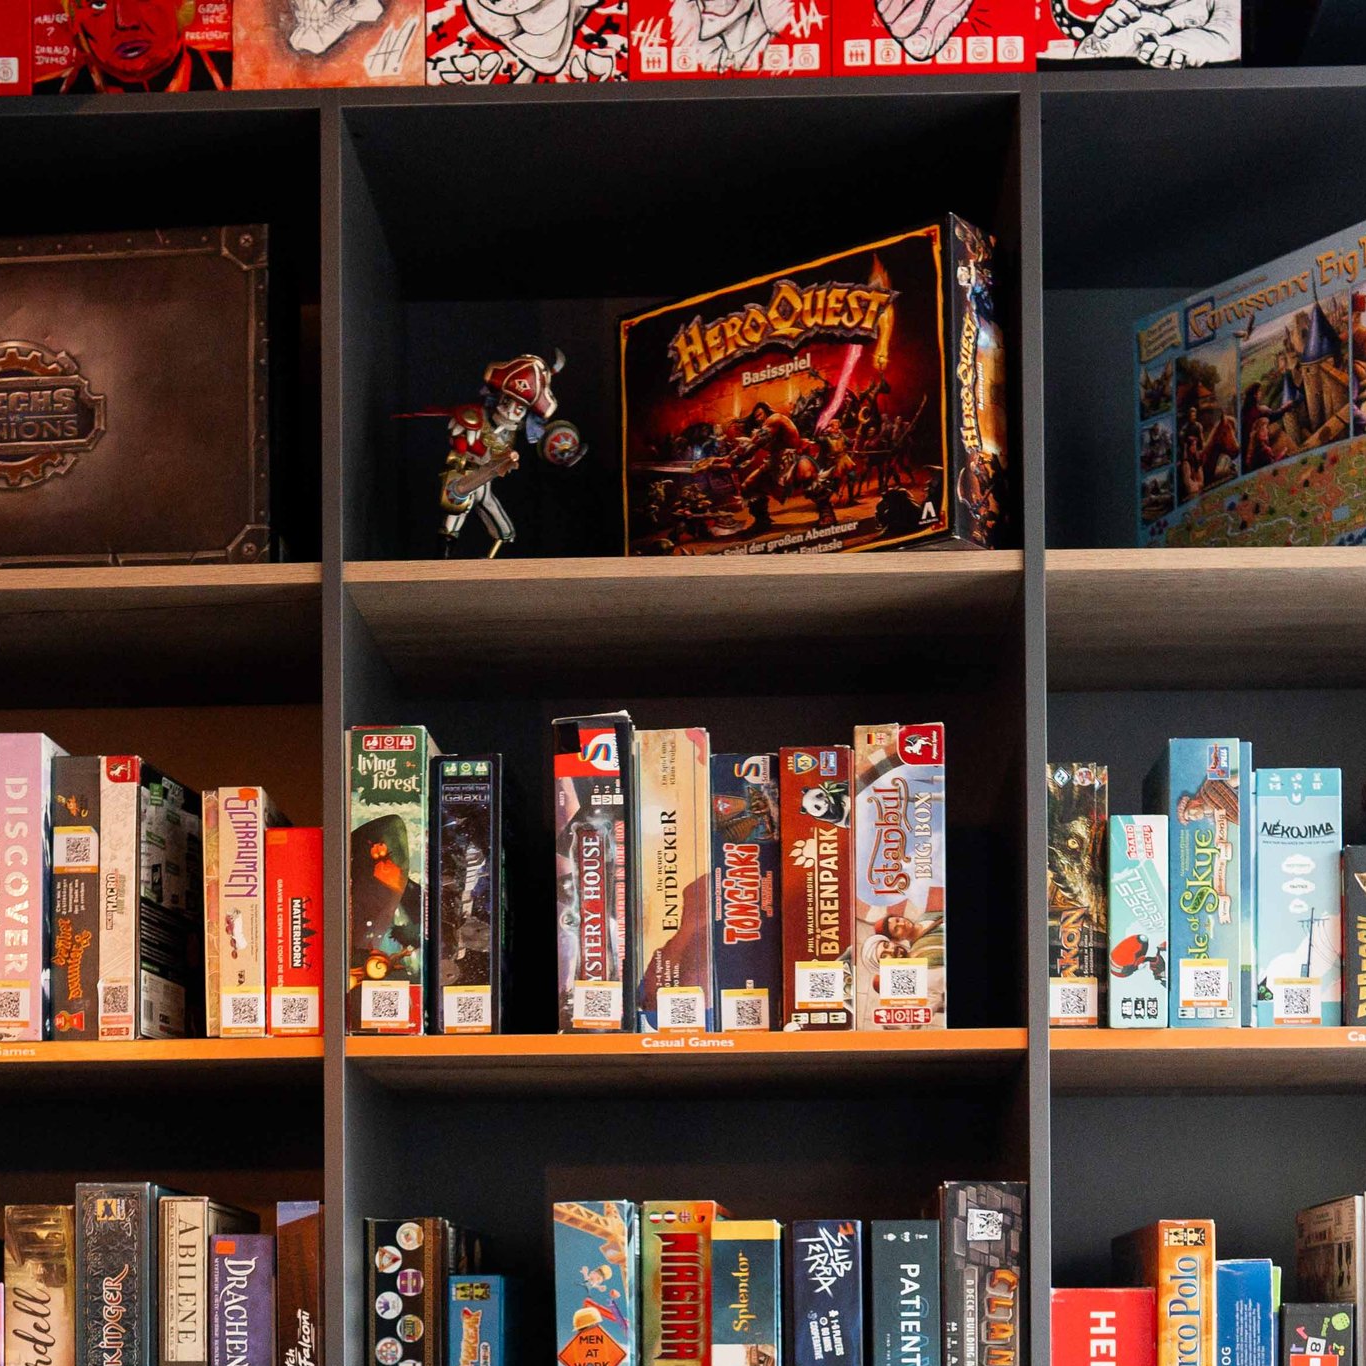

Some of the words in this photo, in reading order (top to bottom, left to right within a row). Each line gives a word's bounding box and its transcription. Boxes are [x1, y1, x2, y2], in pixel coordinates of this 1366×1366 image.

[742, 354, 811, 387] Basisspiel
[916, 793, 931, 835] BOX
[5, 776, 28, 974] DISCOVER
[663, 810, 678, 932] ENTDECKER
[916, 843, 931, 879] BIG
[293, 899, 301, 968] MATTERHORN
[641, 1037, 685, 1048] Casual
[690, 1037, 734, 1048] Games
[179, 1220, 200, 1343] ABILENE
[1168, 1256, 1201, 1316] Polo
[579, 1335, 603, 1344] MEN
[900, 1263, 920, 1366] PATIENT
[586, 1349, 598, 1357] AT
